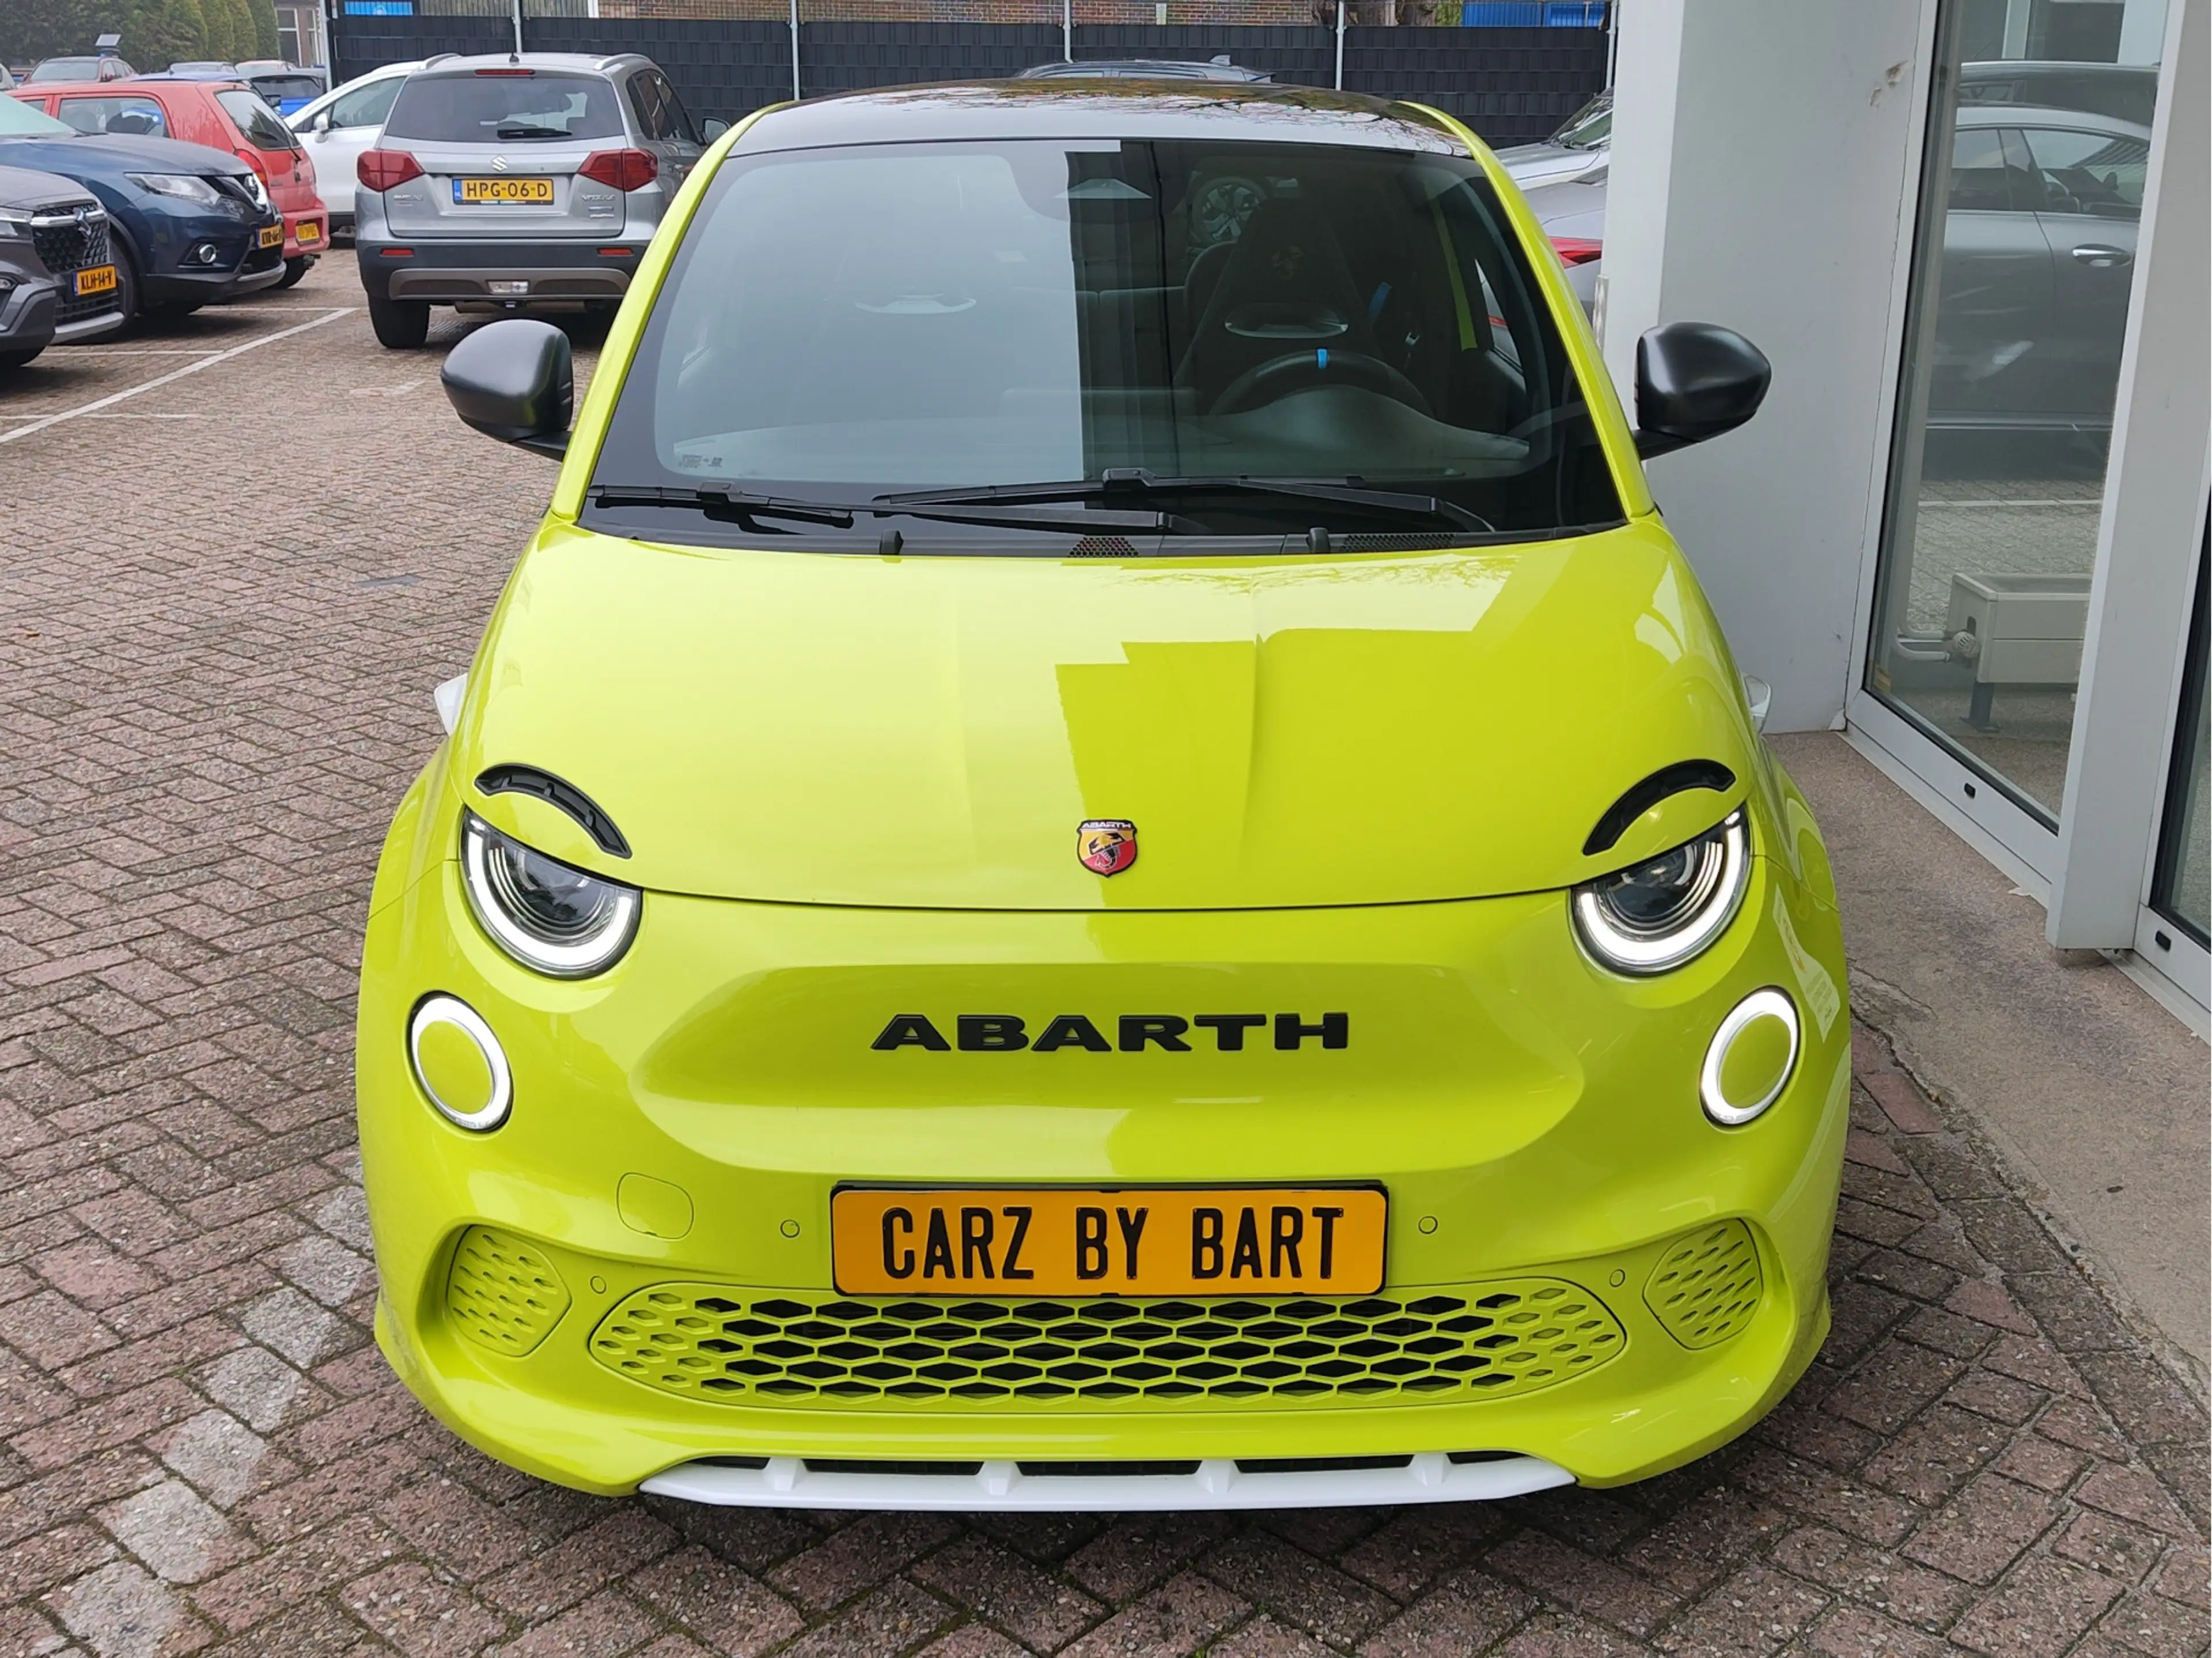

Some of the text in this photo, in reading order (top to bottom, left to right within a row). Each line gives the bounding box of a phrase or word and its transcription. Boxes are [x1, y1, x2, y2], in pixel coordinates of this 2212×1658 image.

[467, 182, 547, 198] HPG-06-D
[871, 1013, 1349, 1051] ABARTH
[882, 1207, 1344, 1280] CARZ BY BART
